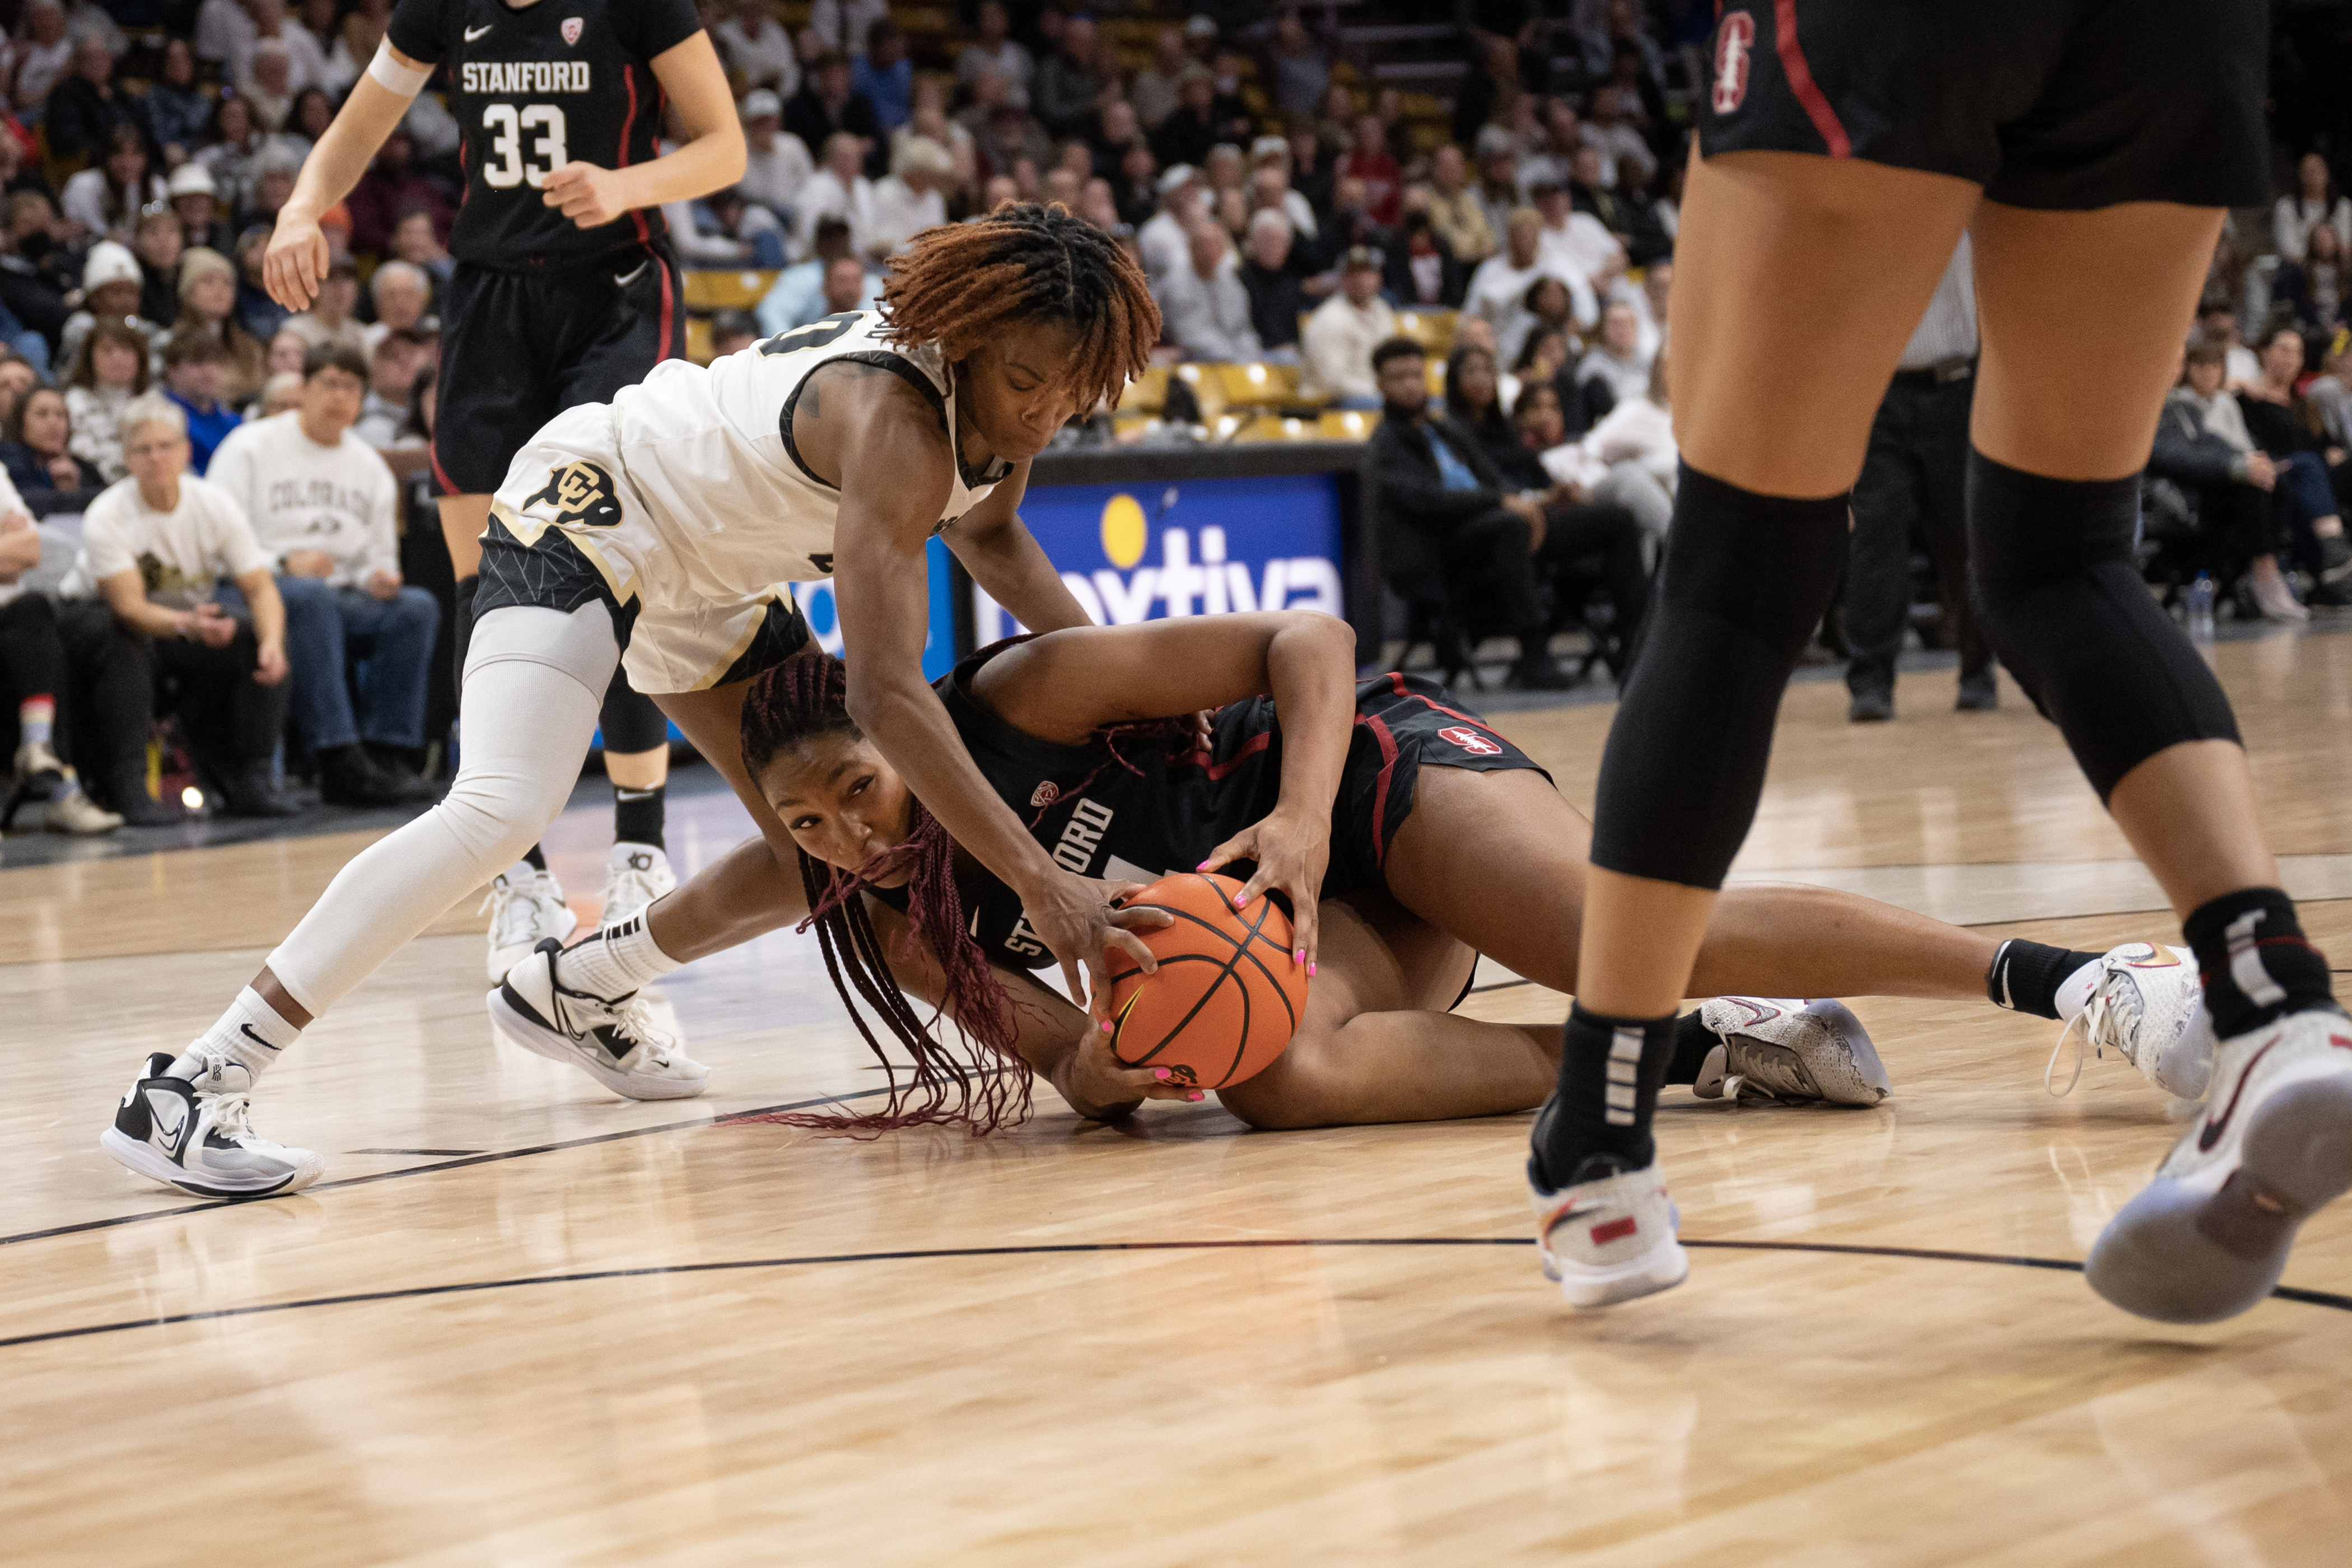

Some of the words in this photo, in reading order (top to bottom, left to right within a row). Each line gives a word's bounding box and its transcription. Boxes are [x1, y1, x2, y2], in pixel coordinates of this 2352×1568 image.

[463, 61, 591, 94] STANFORD
[483, 104, 568, 190] 33
[1004, 797, 1114, 956] STORD
